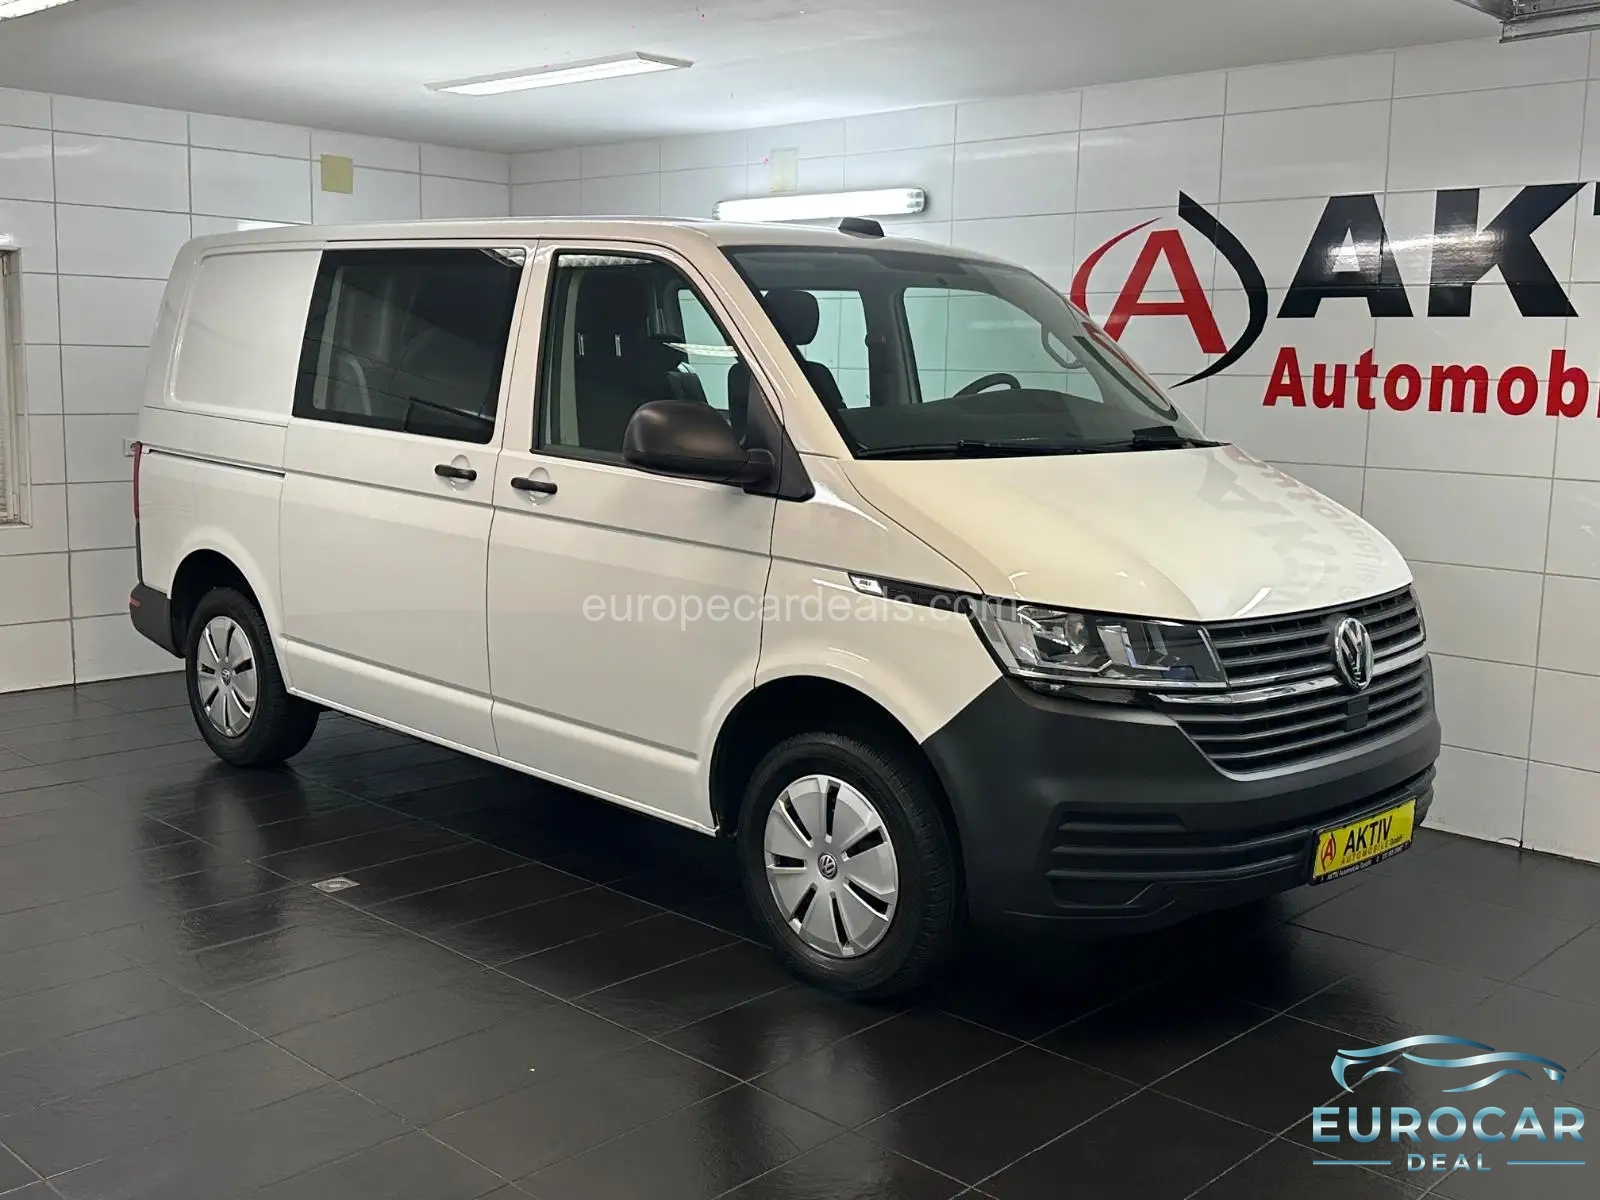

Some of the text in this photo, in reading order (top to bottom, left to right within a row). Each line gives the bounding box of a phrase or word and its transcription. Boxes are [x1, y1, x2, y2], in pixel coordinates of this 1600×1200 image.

[1276, 182, 1600, 318] AK
[1262, 347, 1600, 419] Automob
[1343, 815, 1393, 855] AKTIV
